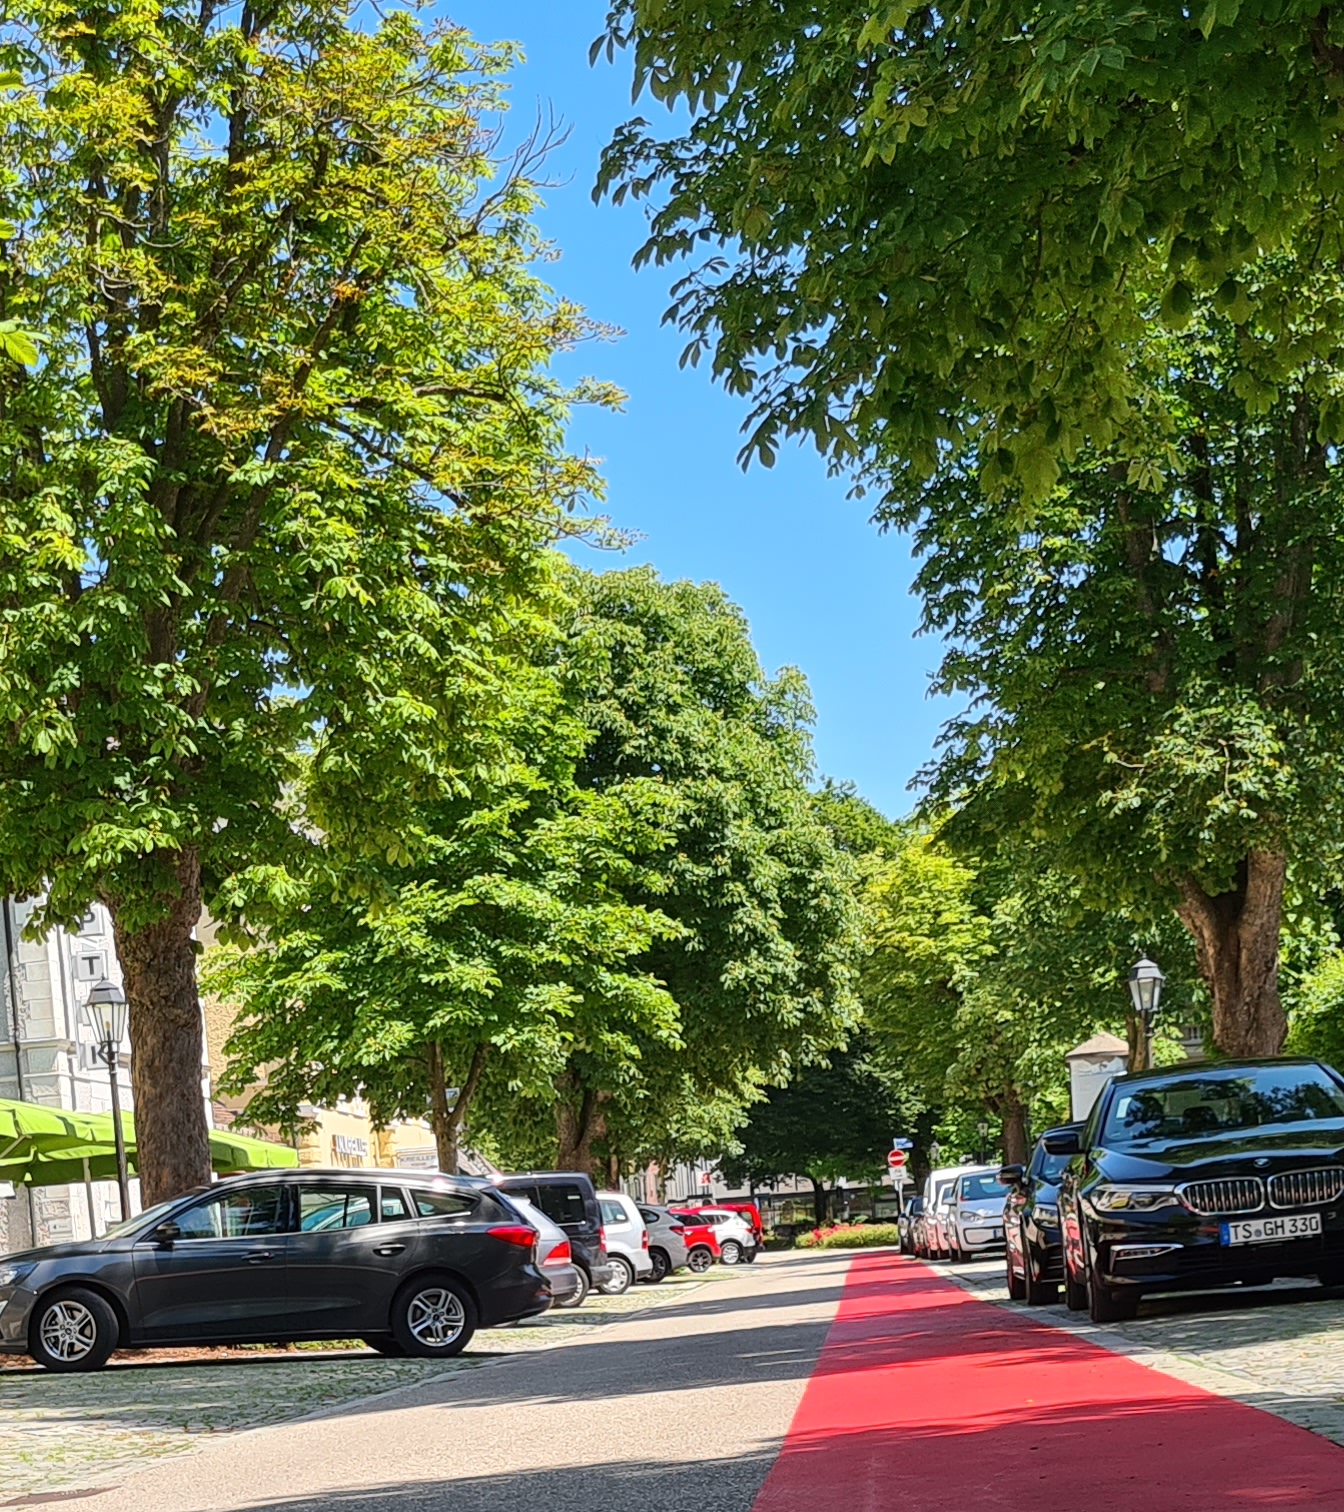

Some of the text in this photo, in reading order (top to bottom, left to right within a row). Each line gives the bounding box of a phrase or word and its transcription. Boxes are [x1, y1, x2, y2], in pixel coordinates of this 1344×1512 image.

[1231, 1216, 1319, 1240] TS GH 330
